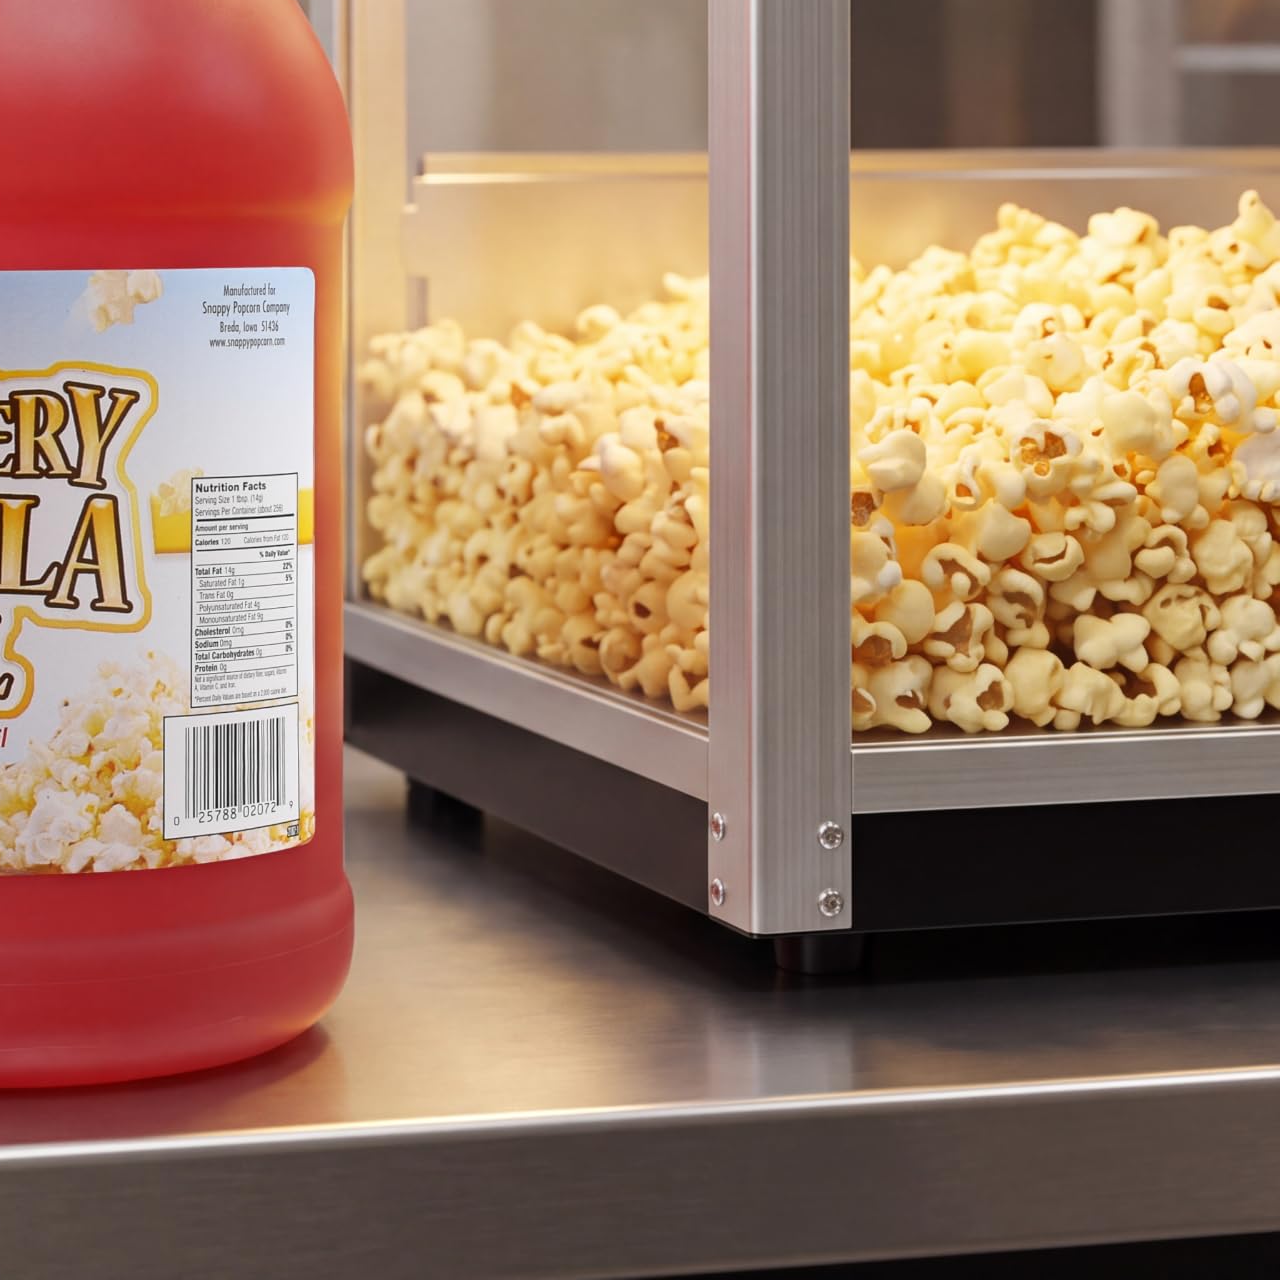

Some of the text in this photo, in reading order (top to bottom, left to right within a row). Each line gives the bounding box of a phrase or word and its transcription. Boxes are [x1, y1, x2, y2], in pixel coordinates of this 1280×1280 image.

[224, 283, 266, 296] Manufactured
[203, 301, 290, 316] Snappy Popcorn Company
[220, 320, 279, 334] Breda, Iowa 51436
[210, 338, 285, 348] www.snappypopcorn.com
[196, 482, 266, 492] Nutrition Facts
[195, 497, 216, 505] Serving
[195, 508, 220, 517] Servings
[232, 506, 256, 514] Container
[244, 536, 262, 544] Calories
[265, 550, 276, 558] Daily
[195, 568, 210, 576] Total
[225, 567, 235, 575] 14g
[283, 562, 292, 570] 22%
[200, 579, 226, 587] Saturated
[238, 578, 244, 587] 1g
[200, 591, 215, 599] Trans
[227, 591, 234, 599] 0g
[200, 601, 243, 612] Polyunsaturated
[254, 601, 260, 610] 4g
[200, 614, 246, 624] Monounsaturated
[257, 613, 263, 621] 9g
[195, 627, 230, 636] Cholesterol
[232, 626, 244, 635] 0mg
[195, 640, 218, 648] Sodium
[220, 640, 232, 648] 0mg
[212, 649, 254, 660] Carbohydrates
[195, 663, 227, 672] Protein 0g
[174, 817, 179, 825] 0
[199, 808, 237, 823] 25788
[243, 802, 276, 818] 02072
